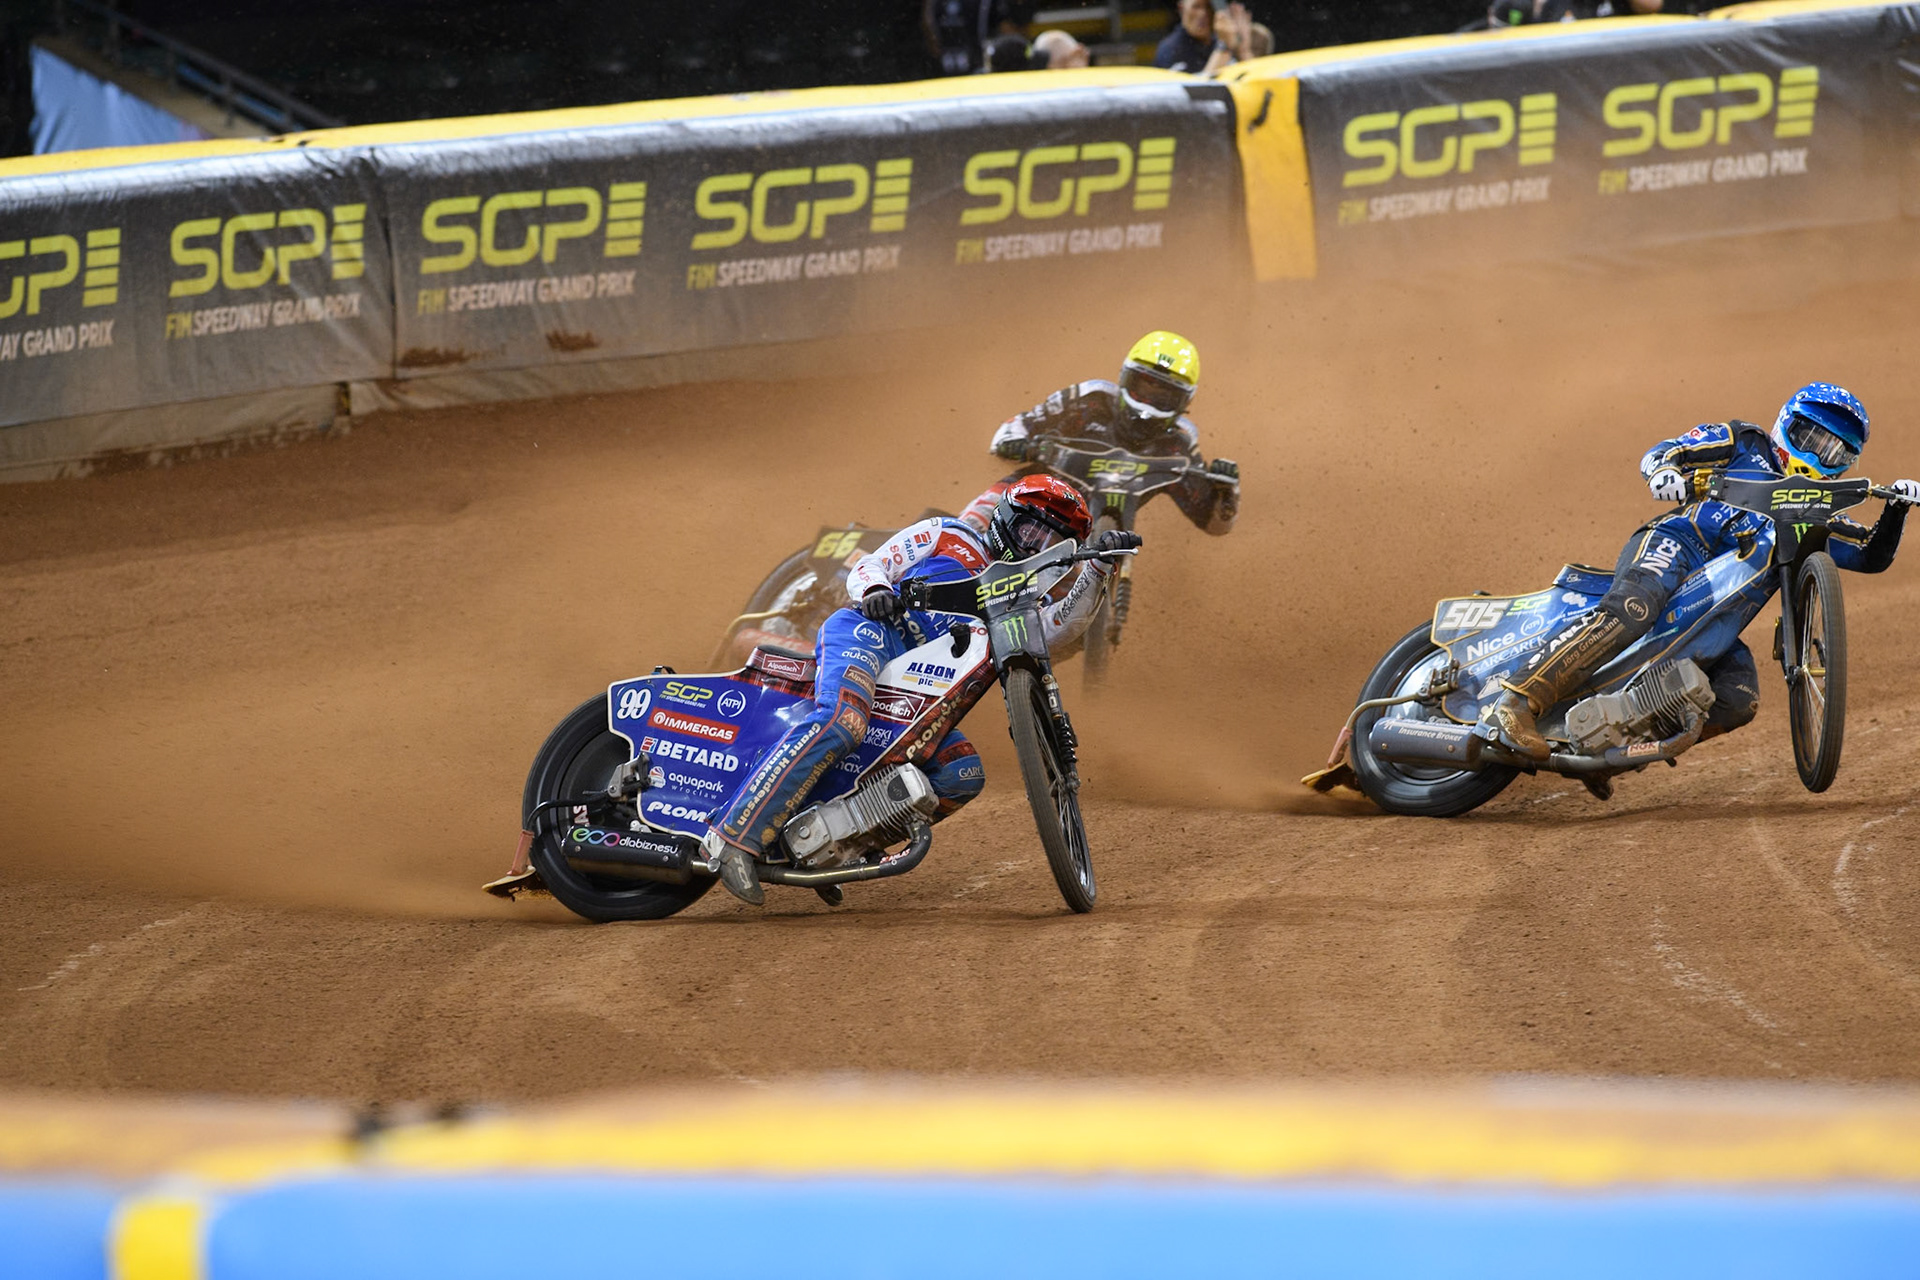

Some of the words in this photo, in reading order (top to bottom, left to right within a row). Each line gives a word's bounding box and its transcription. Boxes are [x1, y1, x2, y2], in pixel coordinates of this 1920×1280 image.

[1600, 168, 1628, 195] FIM
[1628, 159, 1711, 192] SPEEDWAY
[1712, 153, 1769, 183] GRAND
[1769, 149, 1808, 176] PRIX
[1368, 188, 1455, 223] SPEEDWAY
[1455, 181, 1511, 212] GRAND
[1512, 176, 1553, 203] PRIX
[984, 231, 1067, 262] SPEEDWAY
[1068, 226, 1122, 255] GRAND
[1123, 222, 1164, 250] PRIX
[716, 255, 802, 288] SPEEDWAY
[804, 248, 861, 279] GRAND
[862, 245, 901, 274] PRIX
[448, 278, 537, 312] SPEEDWAY
[536, 273, 595, 303] GRAND
[596, 269, 637, 298] PRIX
[165, 311, 193, 341] FIM
[192, 301, 273, 336] SPEEDWAY
[272, 298, 326, 326] GRAND
[324, 292, 362, 320] PRIX
[22, 323, 76, 358] GRAND
[78, 319, 114, 350] PRIX
[812, 531, 864, 560] 66
[903, 538, 916, 562] TARD
[1639, 537, 1682, 578] Nice
[984, 594, 1010, 608] SPEEDWAY
[1026, 585, 1038, 594] PRIX
[1627, 601, 1646, 616] ATPI
[1439, 600, 1512, 630] 505
[859, 626, 883, 643] ATPI
[1466, 632, 1516, 661] Nice
[1579, 616, 1620, 652] Grohmann
[767, 661, 798, 673] Alpodach
[906, 661, 956, 680] ALBON
[1467, 636, 1548, 676] GARCAREK
[616, 688, 652, 720] 99
[661, 680, 714, 702] SGP
[720, 697, 742, 710] ATPI
[871, 698, 912, 717] podach
[663, 717, 735, 741] IMMERGAS
[790, 722, 822, 757] Grant
[866, 725, 893, 740] WSKI
[1398, 726, 1437, 740] Insurance
[1435, 731, 1463, 743] Broker
[655, 739, 740, 771] BETARD
[749, 742, 791, 793] Tankers
[668, 771, 724, 793] aquapark
[736, 756, 790, 827] Henderson
